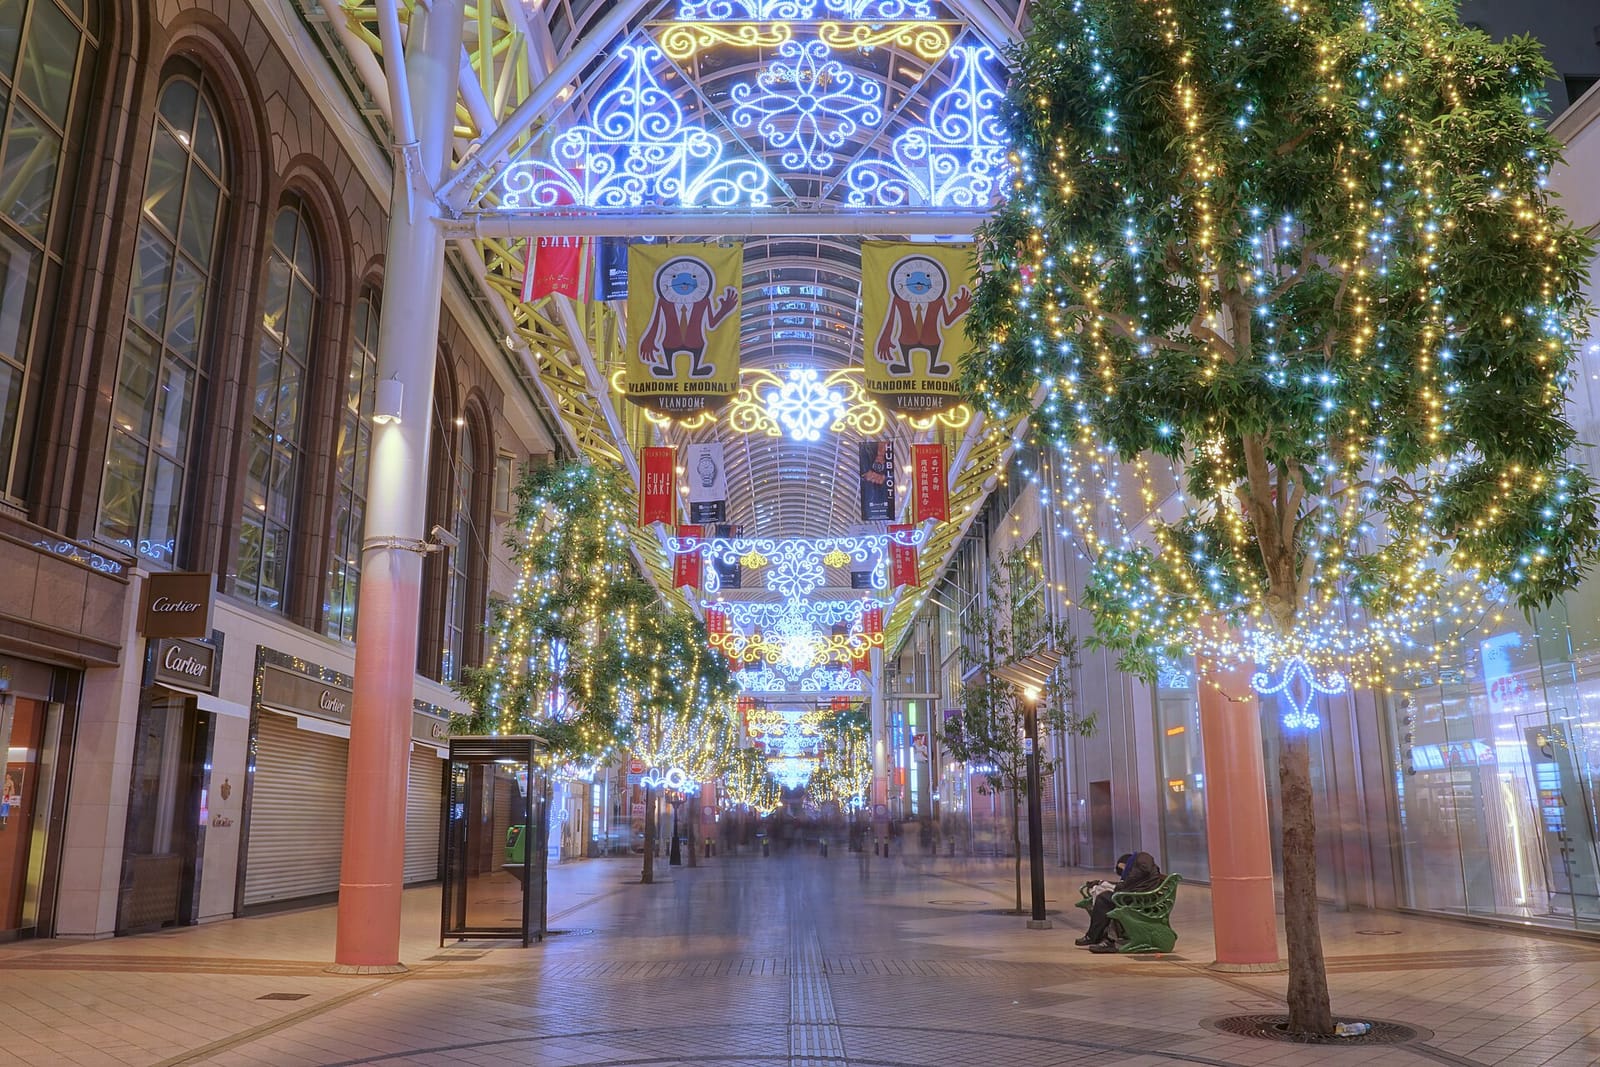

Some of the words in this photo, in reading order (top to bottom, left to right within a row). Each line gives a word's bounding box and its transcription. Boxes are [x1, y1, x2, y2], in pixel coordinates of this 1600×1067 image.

[628, 382, 679, 393] VLANDOME
[866, 380, 917, 391] VLANDOME
[658, 397, 705, 409] VLANDOME
[897, 396, 943, 408] VLANDOME
[885, 443, 894, 497] HUBLOT
[647, 473, 670, 485] FUJI
[647, 483, 670, 495] SAKI
[152, 597, 201, 612] Cartier
[165, 645, 207, 677] Cartier
[320, 690, 345, 713] Cartier
